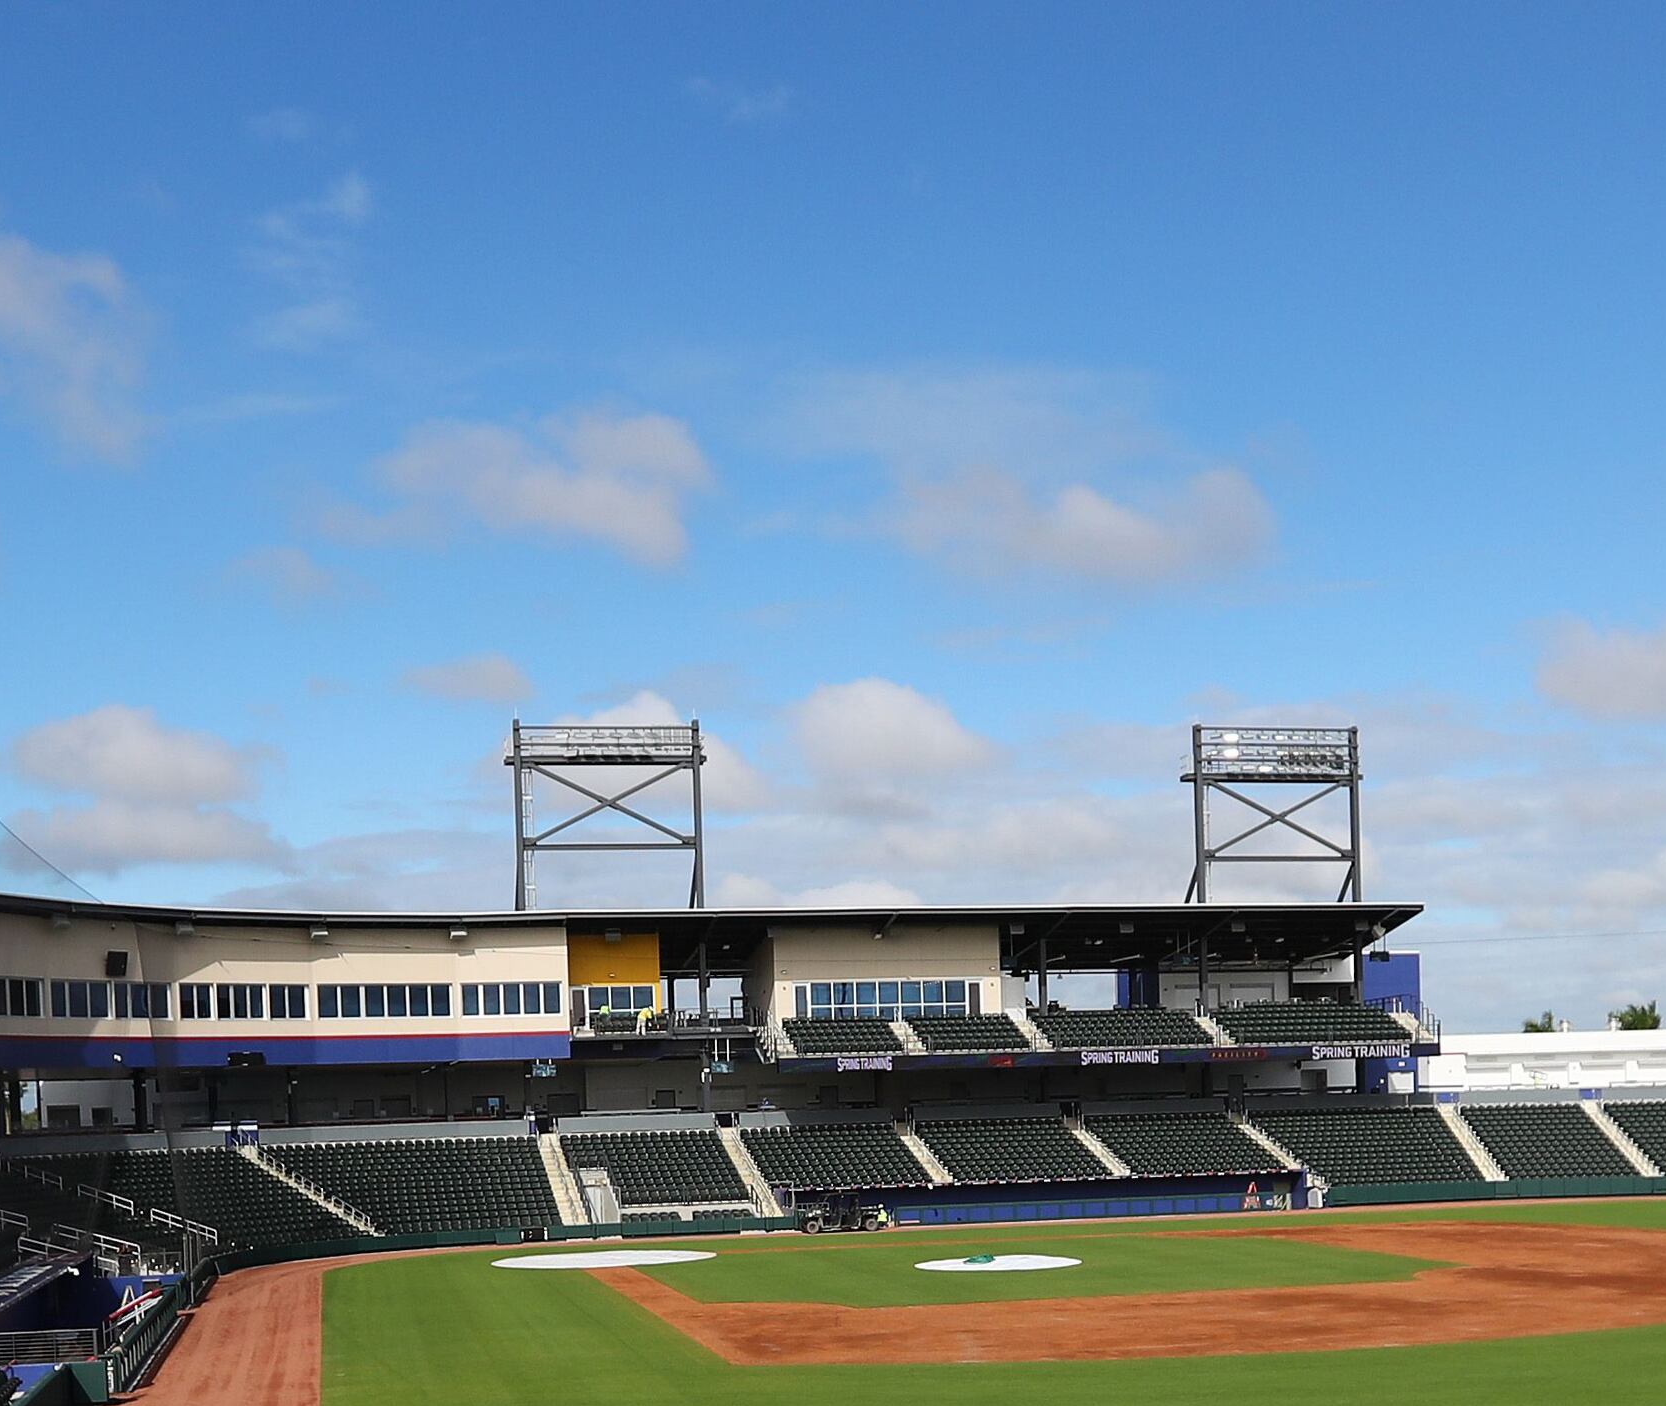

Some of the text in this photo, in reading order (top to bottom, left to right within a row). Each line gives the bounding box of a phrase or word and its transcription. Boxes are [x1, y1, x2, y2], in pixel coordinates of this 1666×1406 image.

[1081, 1049, 1160, 1066] SPRING TRAINING
[1312, 1043, 1411, 1060] SPRING TRAINING
[837, 1056, 893, 1072] SPRING TRAINING
